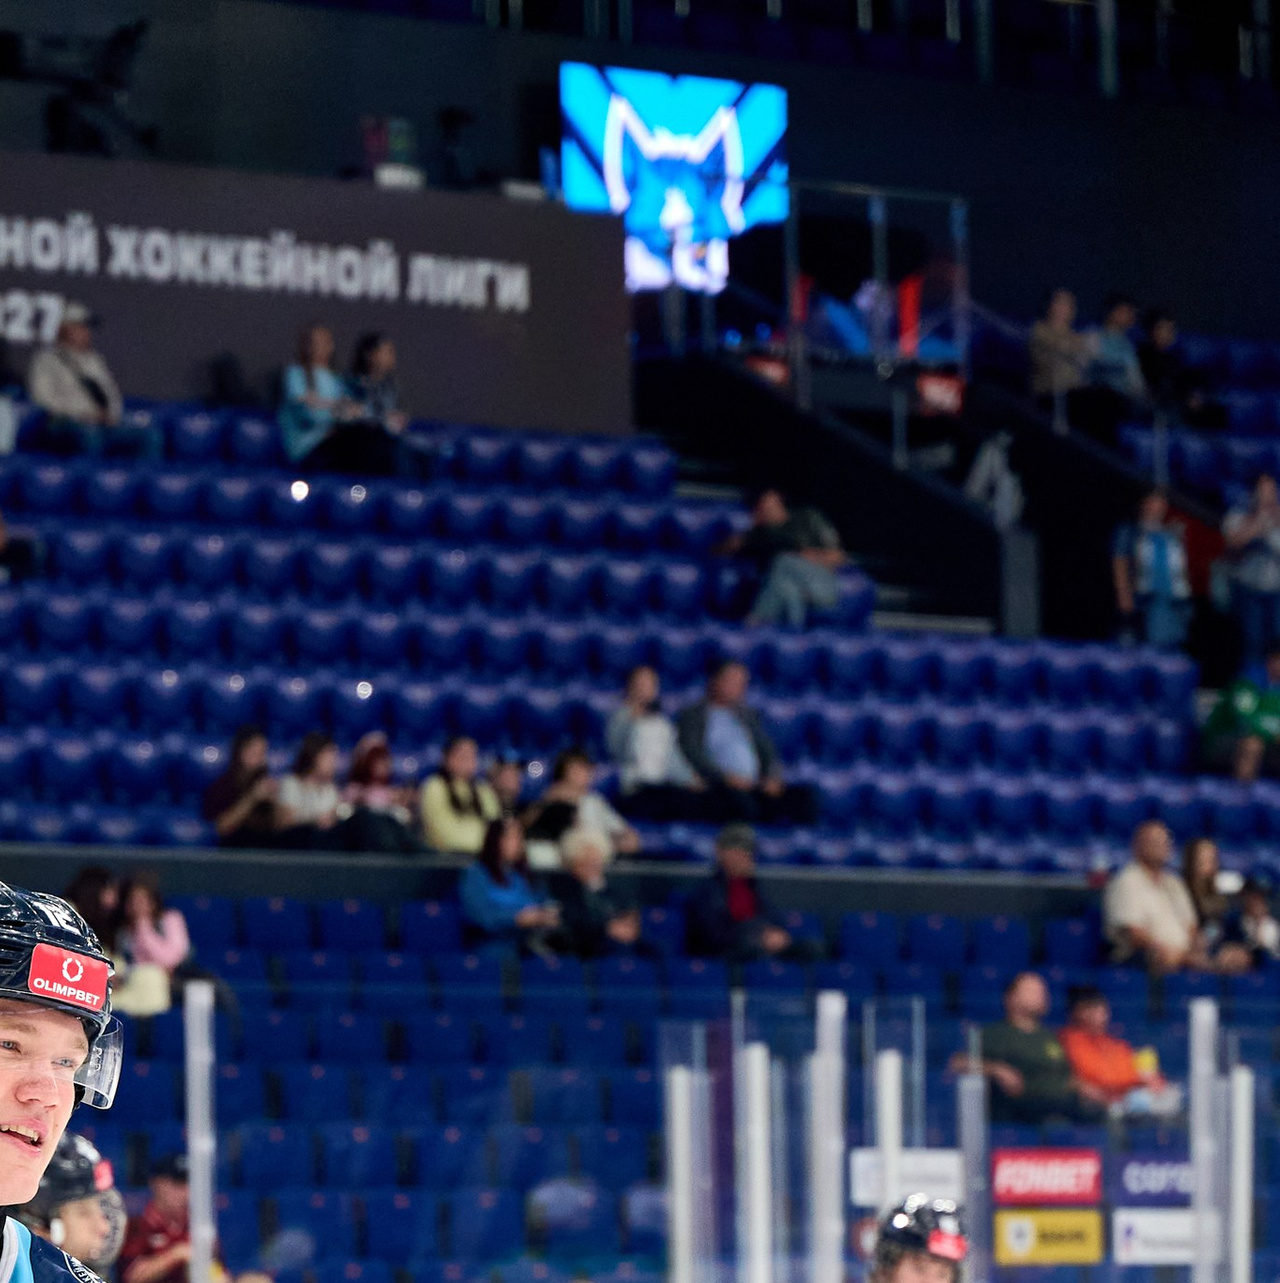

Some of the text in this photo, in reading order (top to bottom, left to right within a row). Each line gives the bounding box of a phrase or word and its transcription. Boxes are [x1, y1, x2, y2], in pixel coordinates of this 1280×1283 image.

[107, 223, 401, 300] ХОККЕЙНОЙ
[406, 252, 531, 313] ЛИГИ
[33, 977, 100, 1006] OLIMPBET
[993, 1156, 1101, 1197] FONBET
